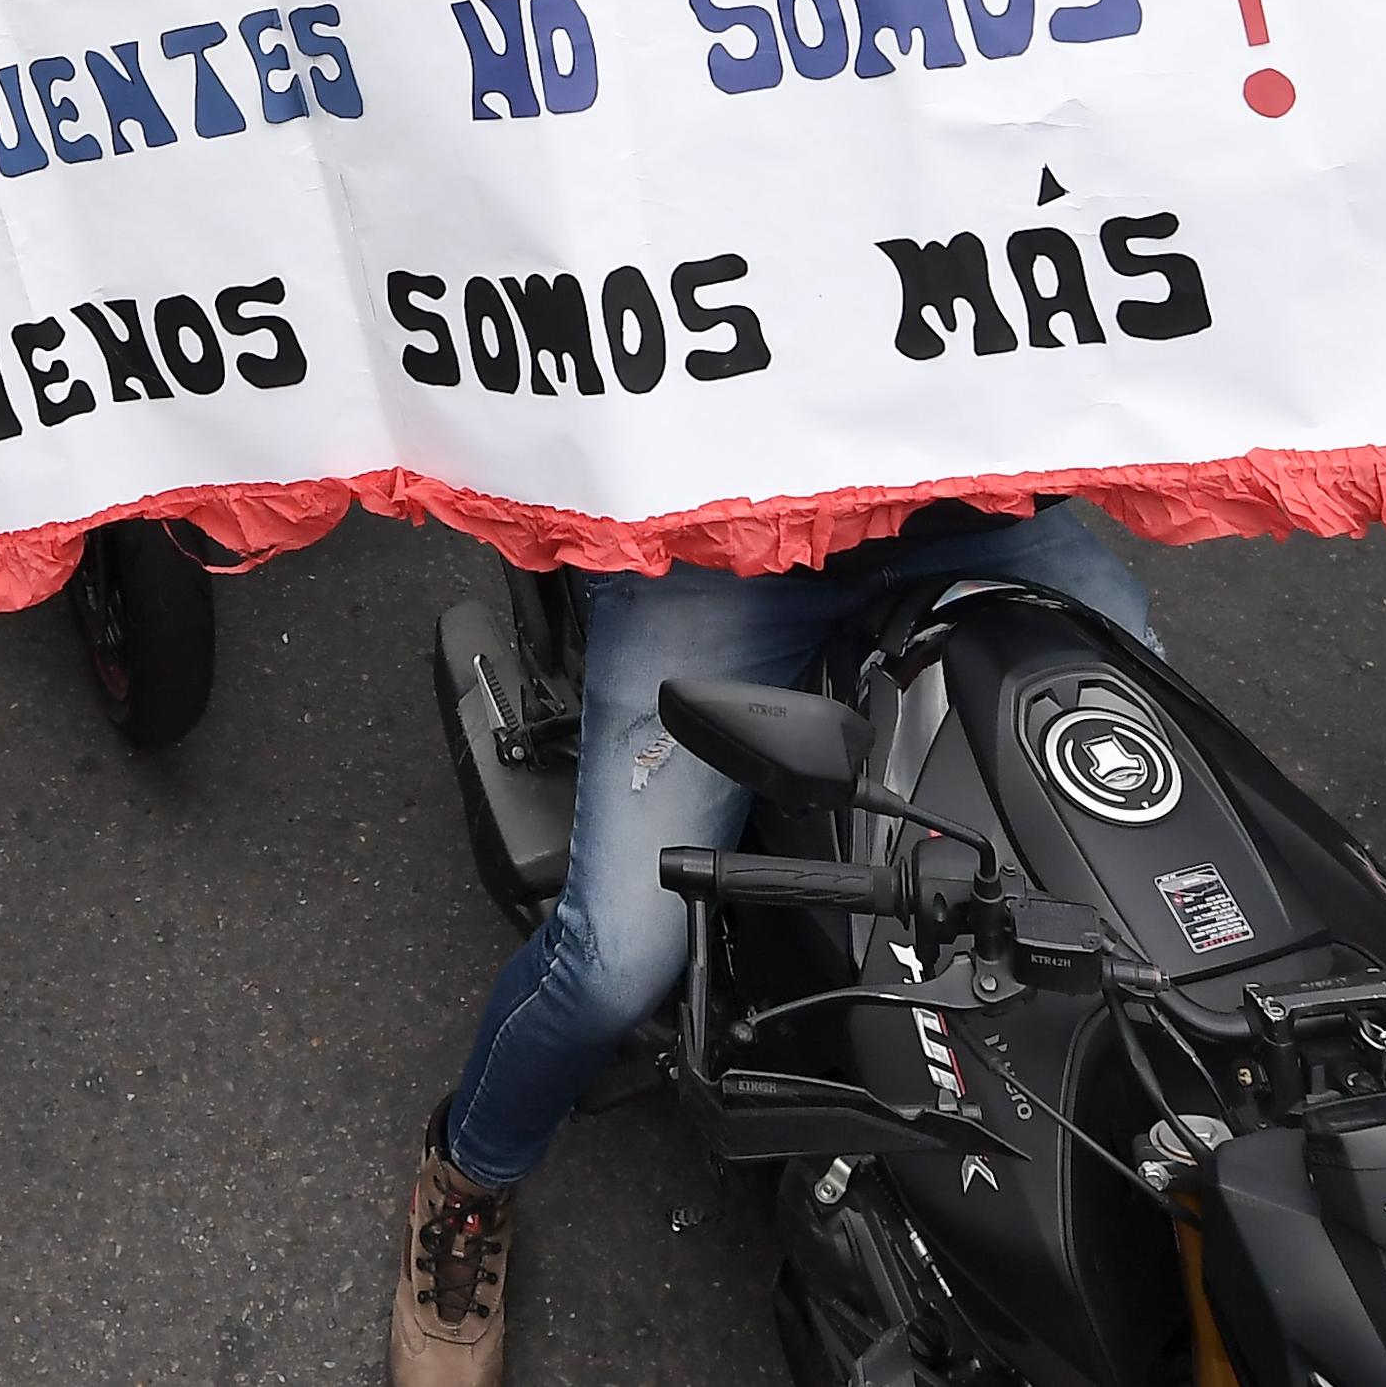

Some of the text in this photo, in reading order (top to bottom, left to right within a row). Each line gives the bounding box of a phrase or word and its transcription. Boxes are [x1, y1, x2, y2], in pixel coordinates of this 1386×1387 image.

[387, 254, 772, 397] SOMOS
[874, 165, 1213, 361] MÁS
[1030, 953, 1072, 969] KTR42H
